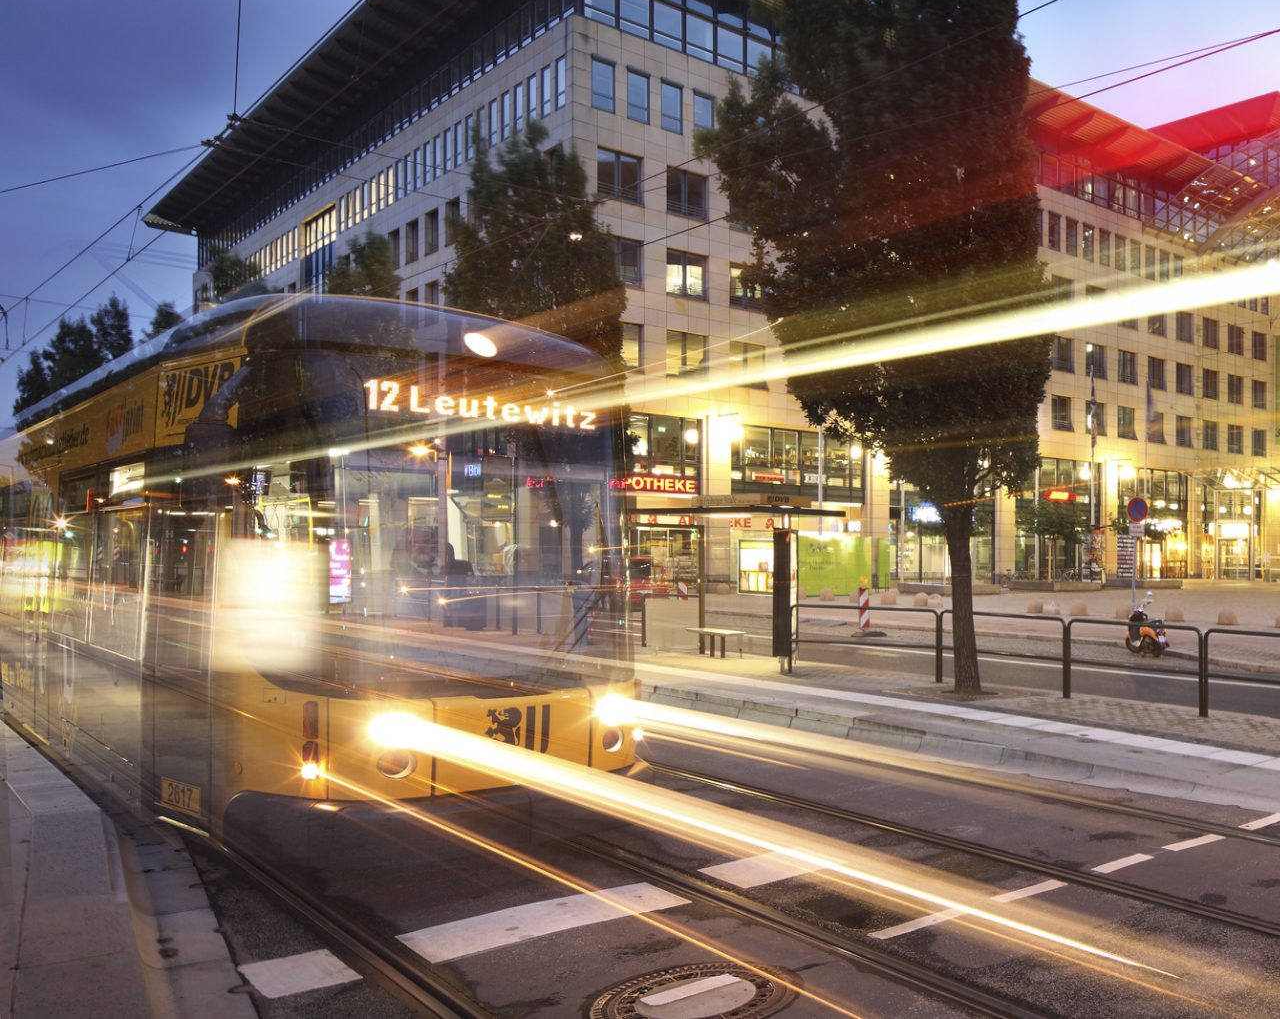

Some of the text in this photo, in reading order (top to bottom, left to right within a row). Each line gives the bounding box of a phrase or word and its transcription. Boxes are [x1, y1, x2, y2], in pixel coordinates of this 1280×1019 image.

[364, 379, 597, 431] 12 Leutewitz
[167, 782, 193, 808] 2617
